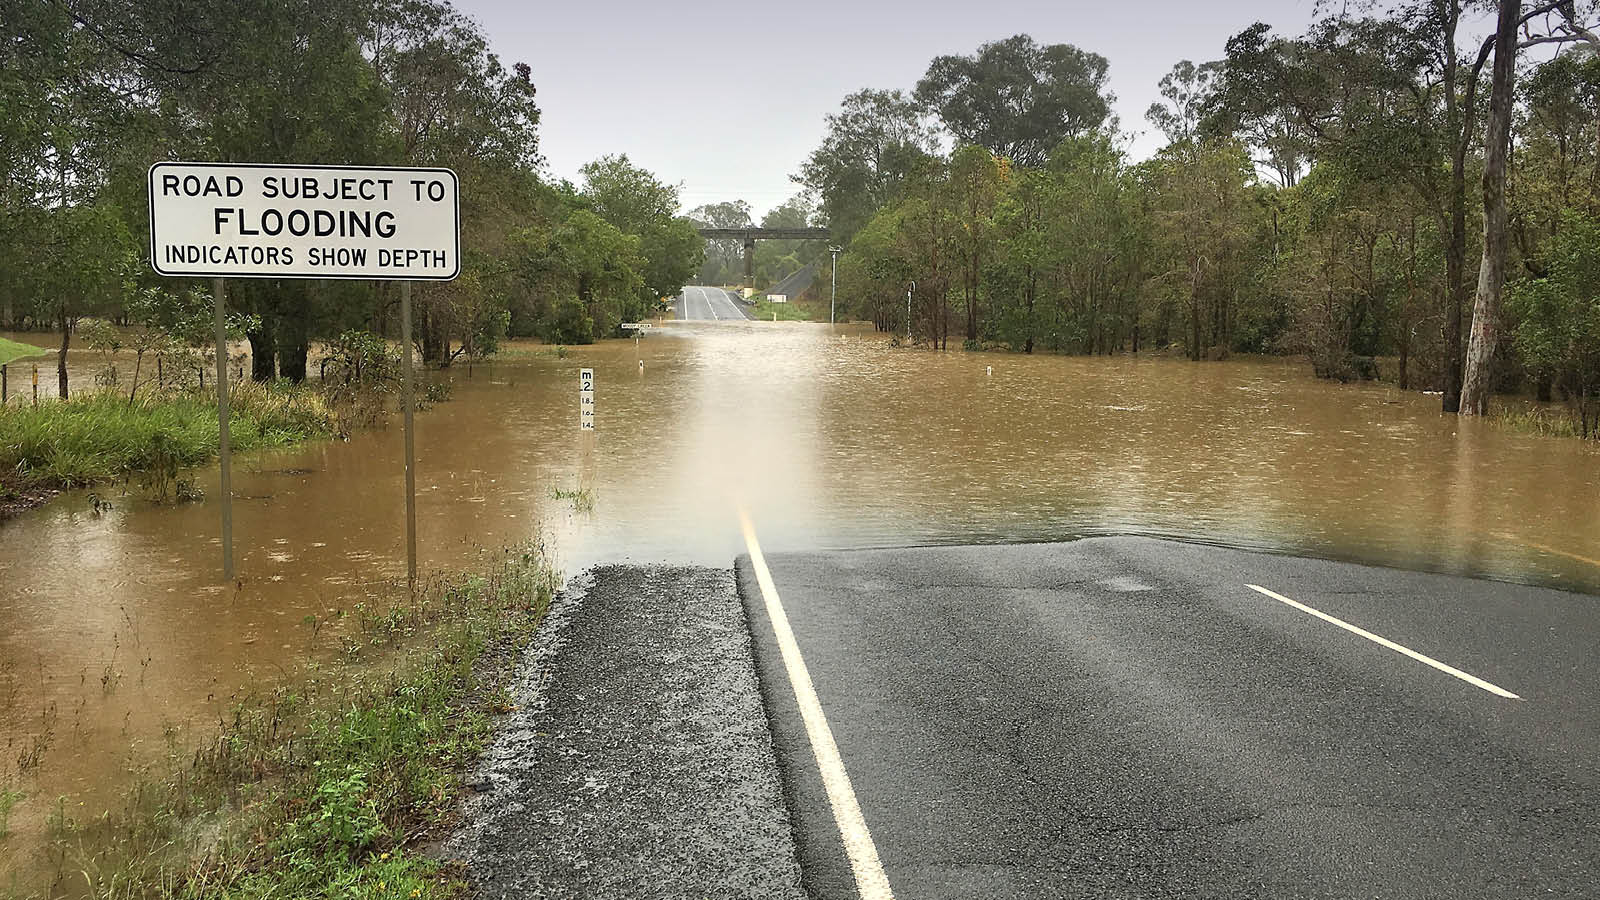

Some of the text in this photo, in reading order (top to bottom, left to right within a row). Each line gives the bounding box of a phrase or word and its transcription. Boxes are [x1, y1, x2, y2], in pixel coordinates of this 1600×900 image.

[163, 174, 445, 202] ROAD SUBJECT TO
[214, 208, 396, 238] FLOODING
[165, 245, 446, 268] INDICATORS SHOW DEPTH
[584, 382, 590, 391] 2
